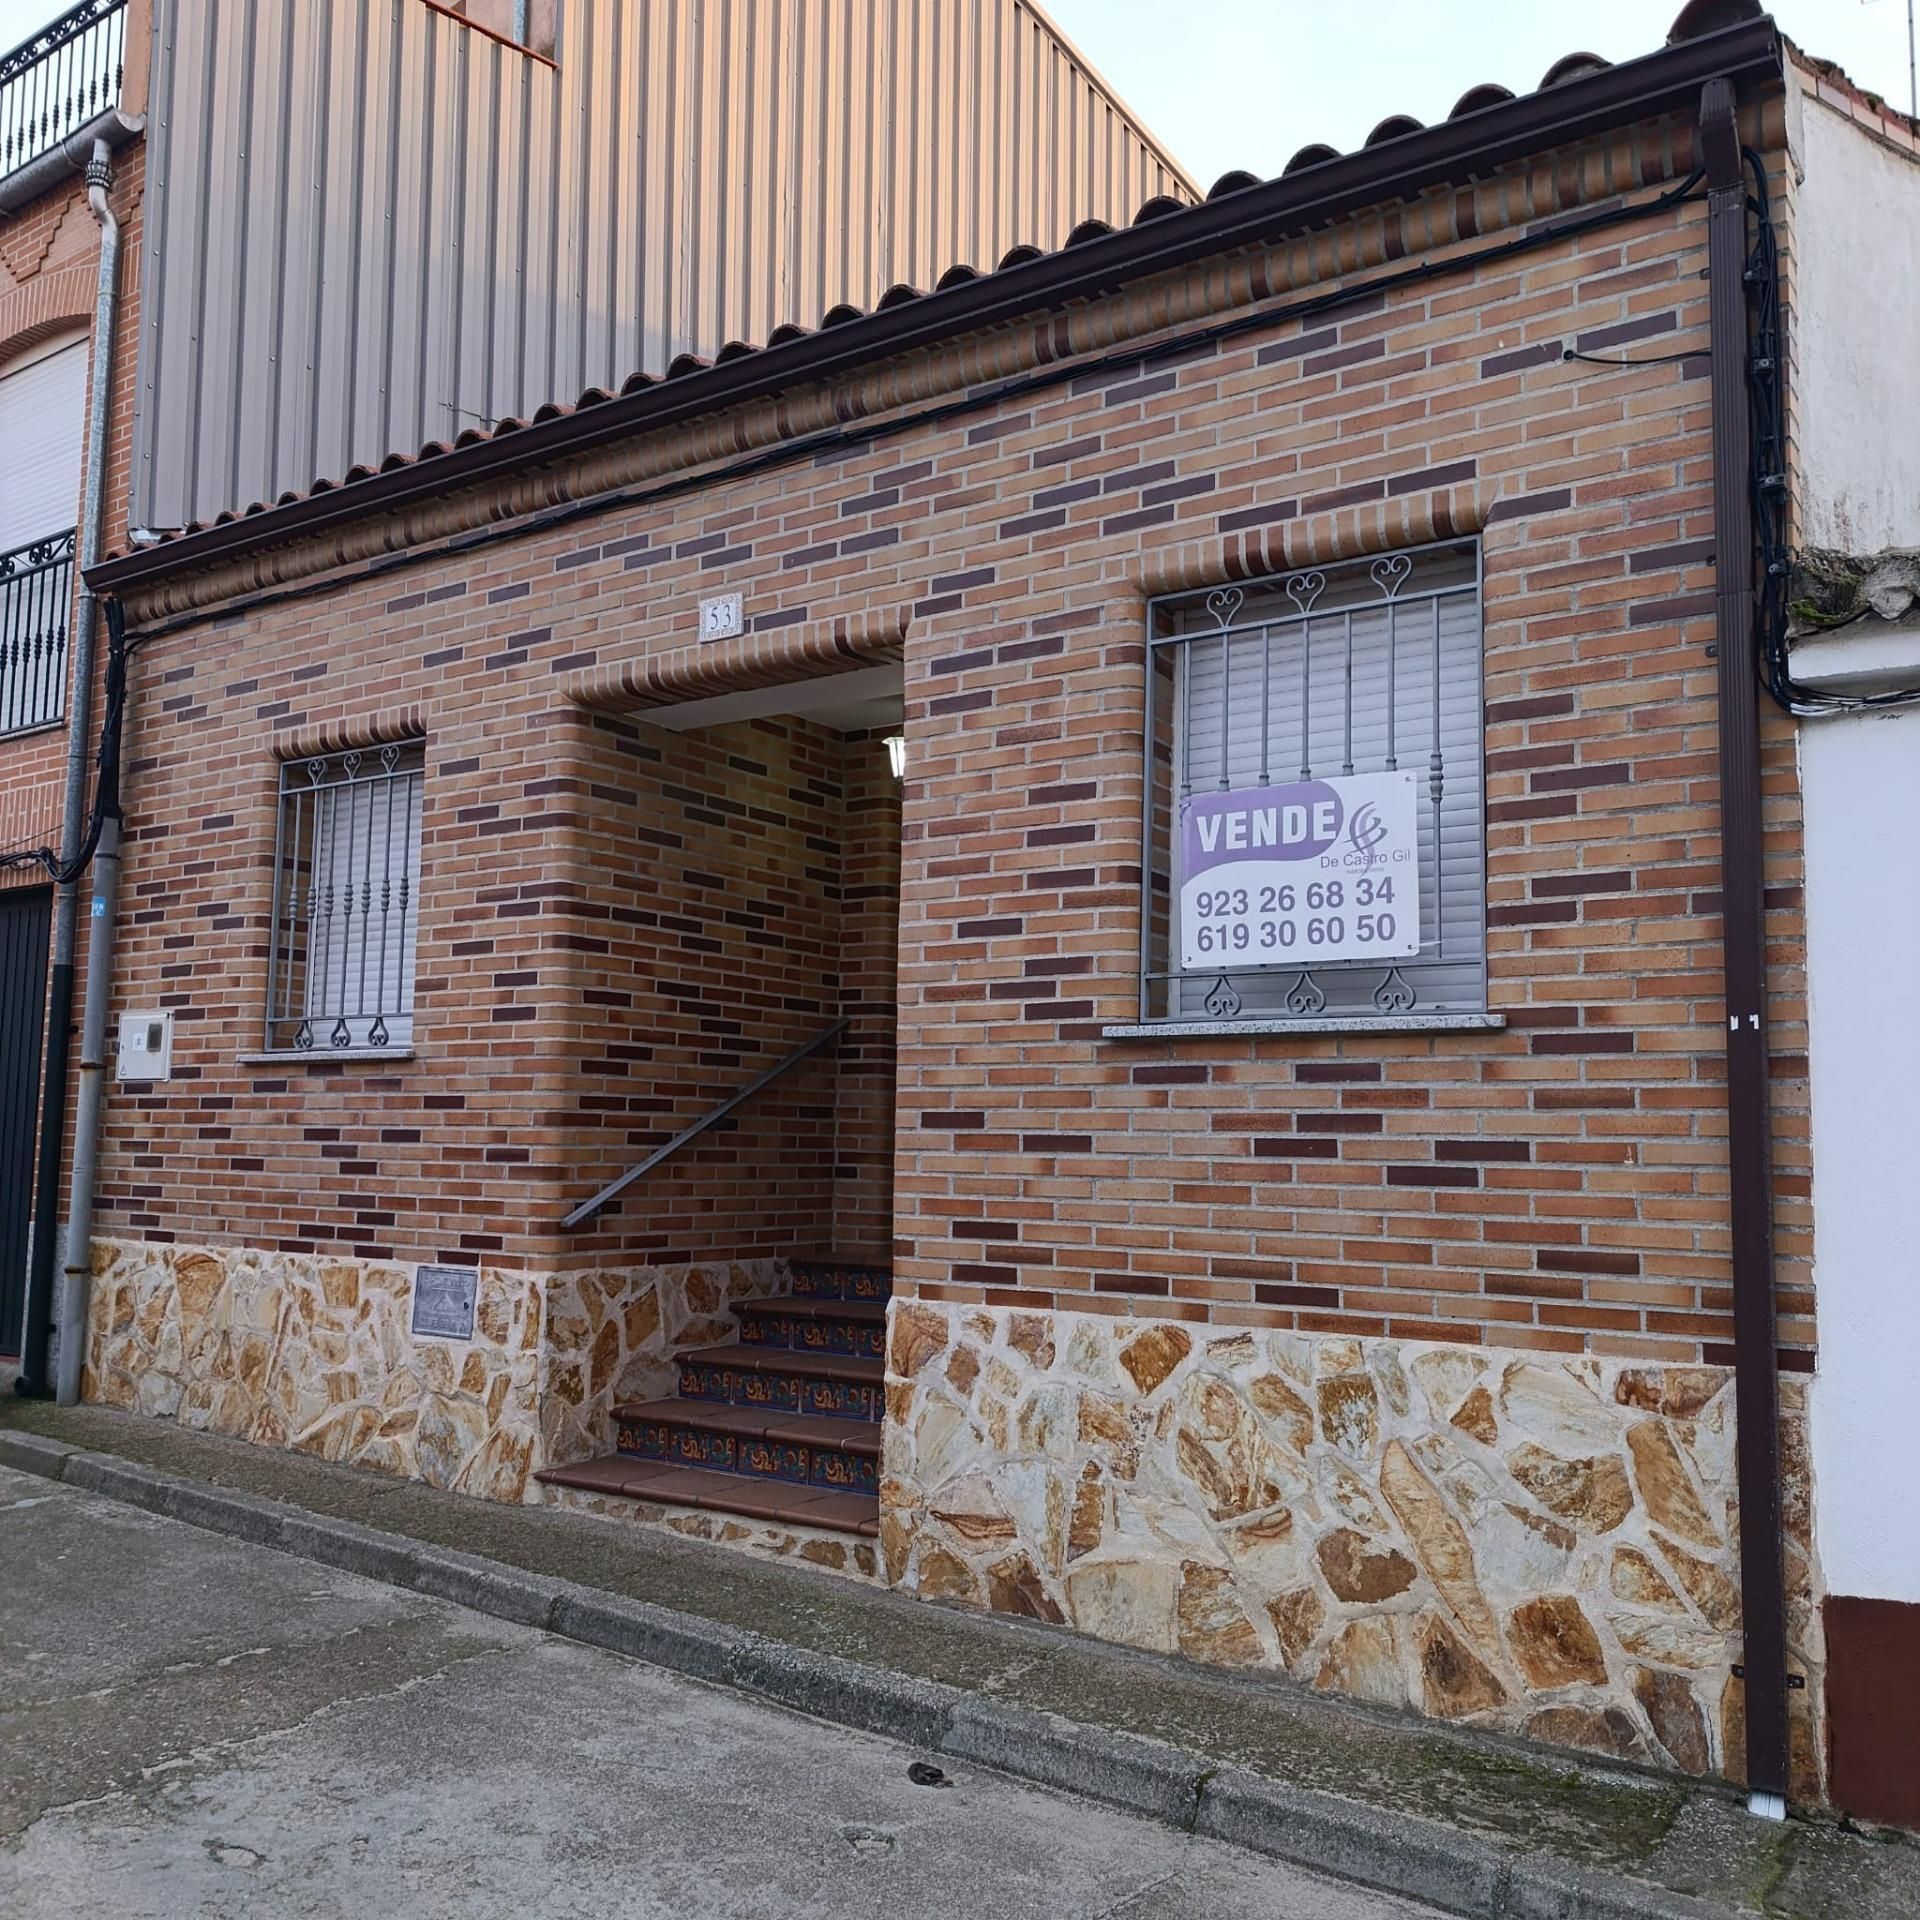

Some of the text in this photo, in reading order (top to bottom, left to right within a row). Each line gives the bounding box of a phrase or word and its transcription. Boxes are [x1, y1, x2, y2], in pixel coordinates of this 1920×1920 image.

[710, 604, 731, 630] 53
[1197, 800, 1336, 852] VENDE
[1320, 848, 1411, 869] De Castro Gil
[1196, 876, 1396, 918] 923 26 68 34
[1197, 913, 1397, 952] 619 30 60 50
